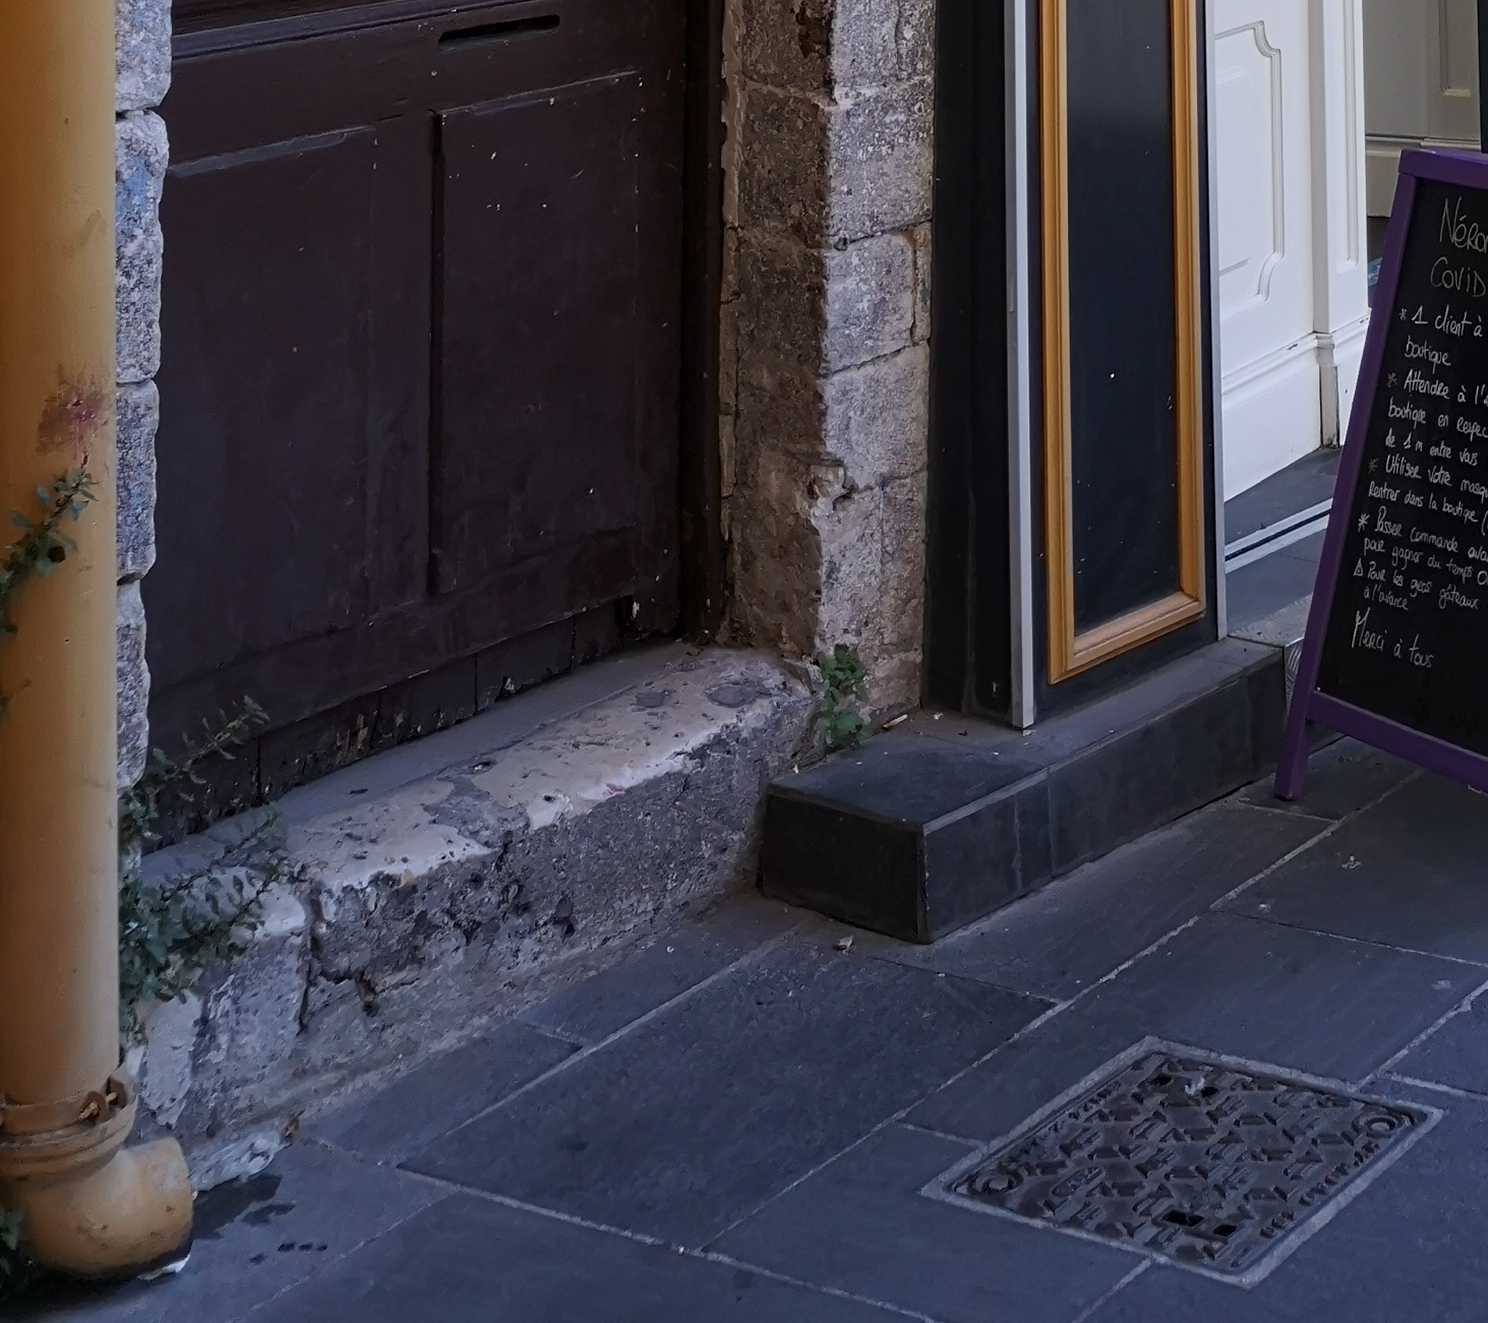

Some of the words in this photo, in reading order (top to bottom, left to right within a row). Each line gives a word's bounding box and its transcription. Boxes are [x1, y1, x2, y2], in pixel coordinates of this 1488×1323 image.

[1411, 305, 1429, 325] 1
[1434, 304, 1472, 338] client
[1473, 315, 1483, 339] à
[1404, 335, 1451, 374] boutique
[1457, 385, 1466, 403] à
[1388, 397, 1427, 429] boutique
[1437, 413, 1449, 428] en
[1385, 427, 1396, 448] de
[1430, 444, 1452, 459] entre
[1404, 489, 1424, 508] dans
[1429, 492, 1438, 510] la
[1442, 496, 1479, 526] boutique
[1427, 553, 1441, 570] du
[1446, 558, 1474, 584] temps
[1439, 583, 1479, 609] gâteaux
[1393, 638, 1403, 658] à
[1409, 633, 1435, 669] tous
